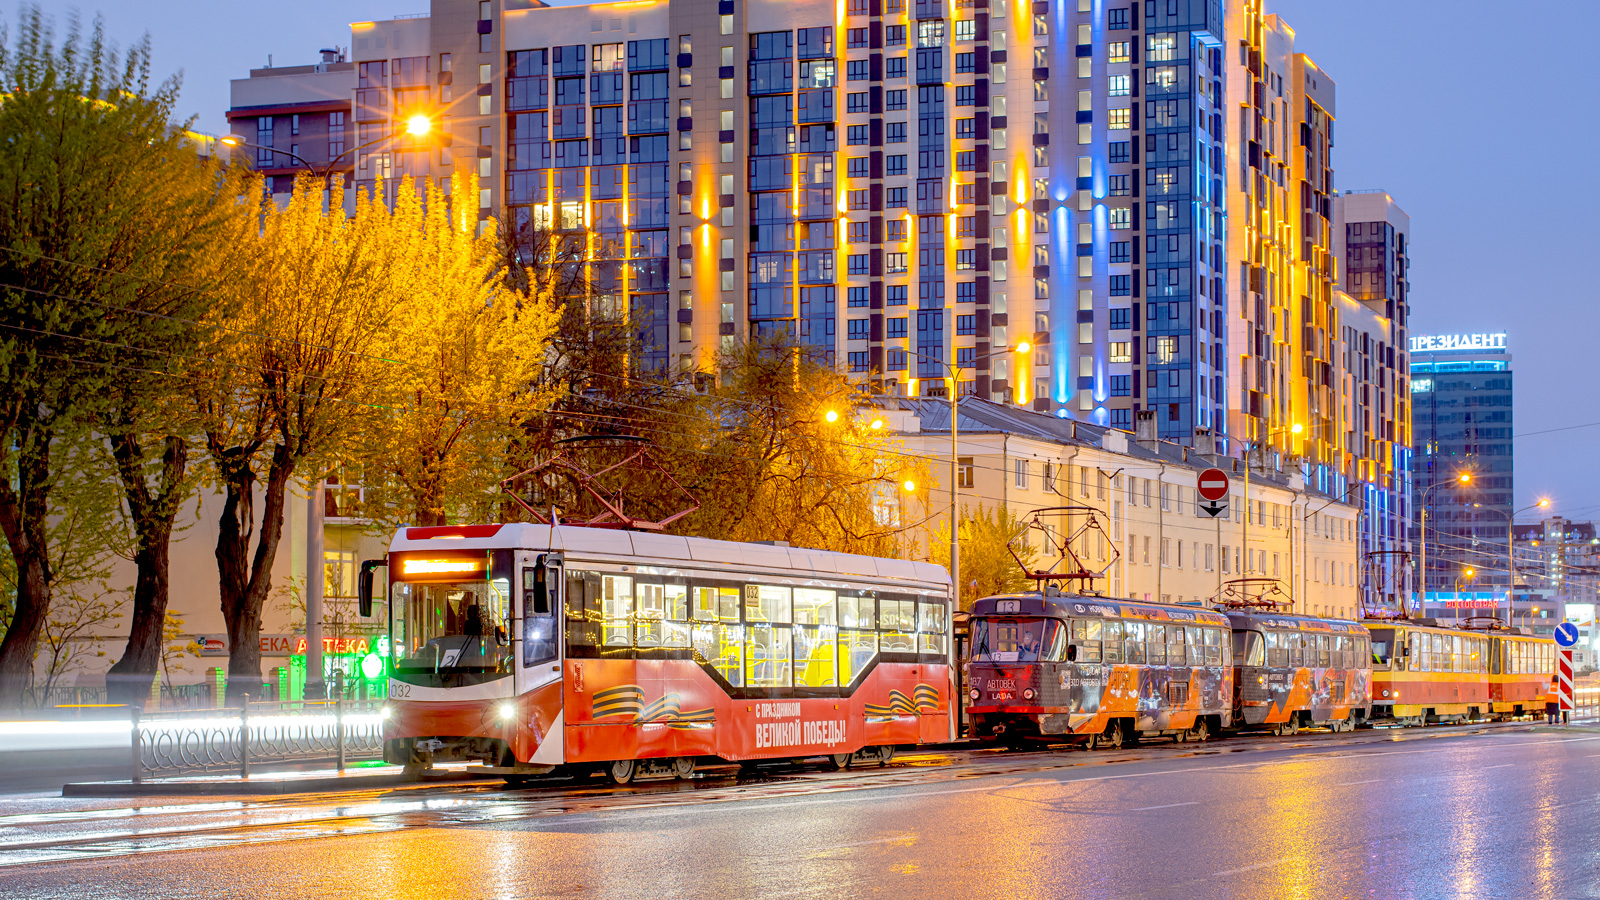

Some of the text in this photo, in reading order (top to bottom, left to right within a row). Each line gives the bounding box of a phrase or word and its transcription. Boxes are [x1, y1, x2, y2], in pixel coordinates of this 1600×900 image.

[1003, 601, 1015, 613] 13
[1446, 600, 1499, 609] РОСГОССТРАХ
[296, 638, 370, 654] АТЕКА
[986, 679, 1016, 689] АВТОВЕК
[391, 684, 410, 698] 032
[992, 692, 1013, 700] LADA
[755, 702, 801, 719] С ПРАЗДНИКОМ
[756, 719, 846, 748] ВЕЛИКОЙ ПОБЕДЫ!
